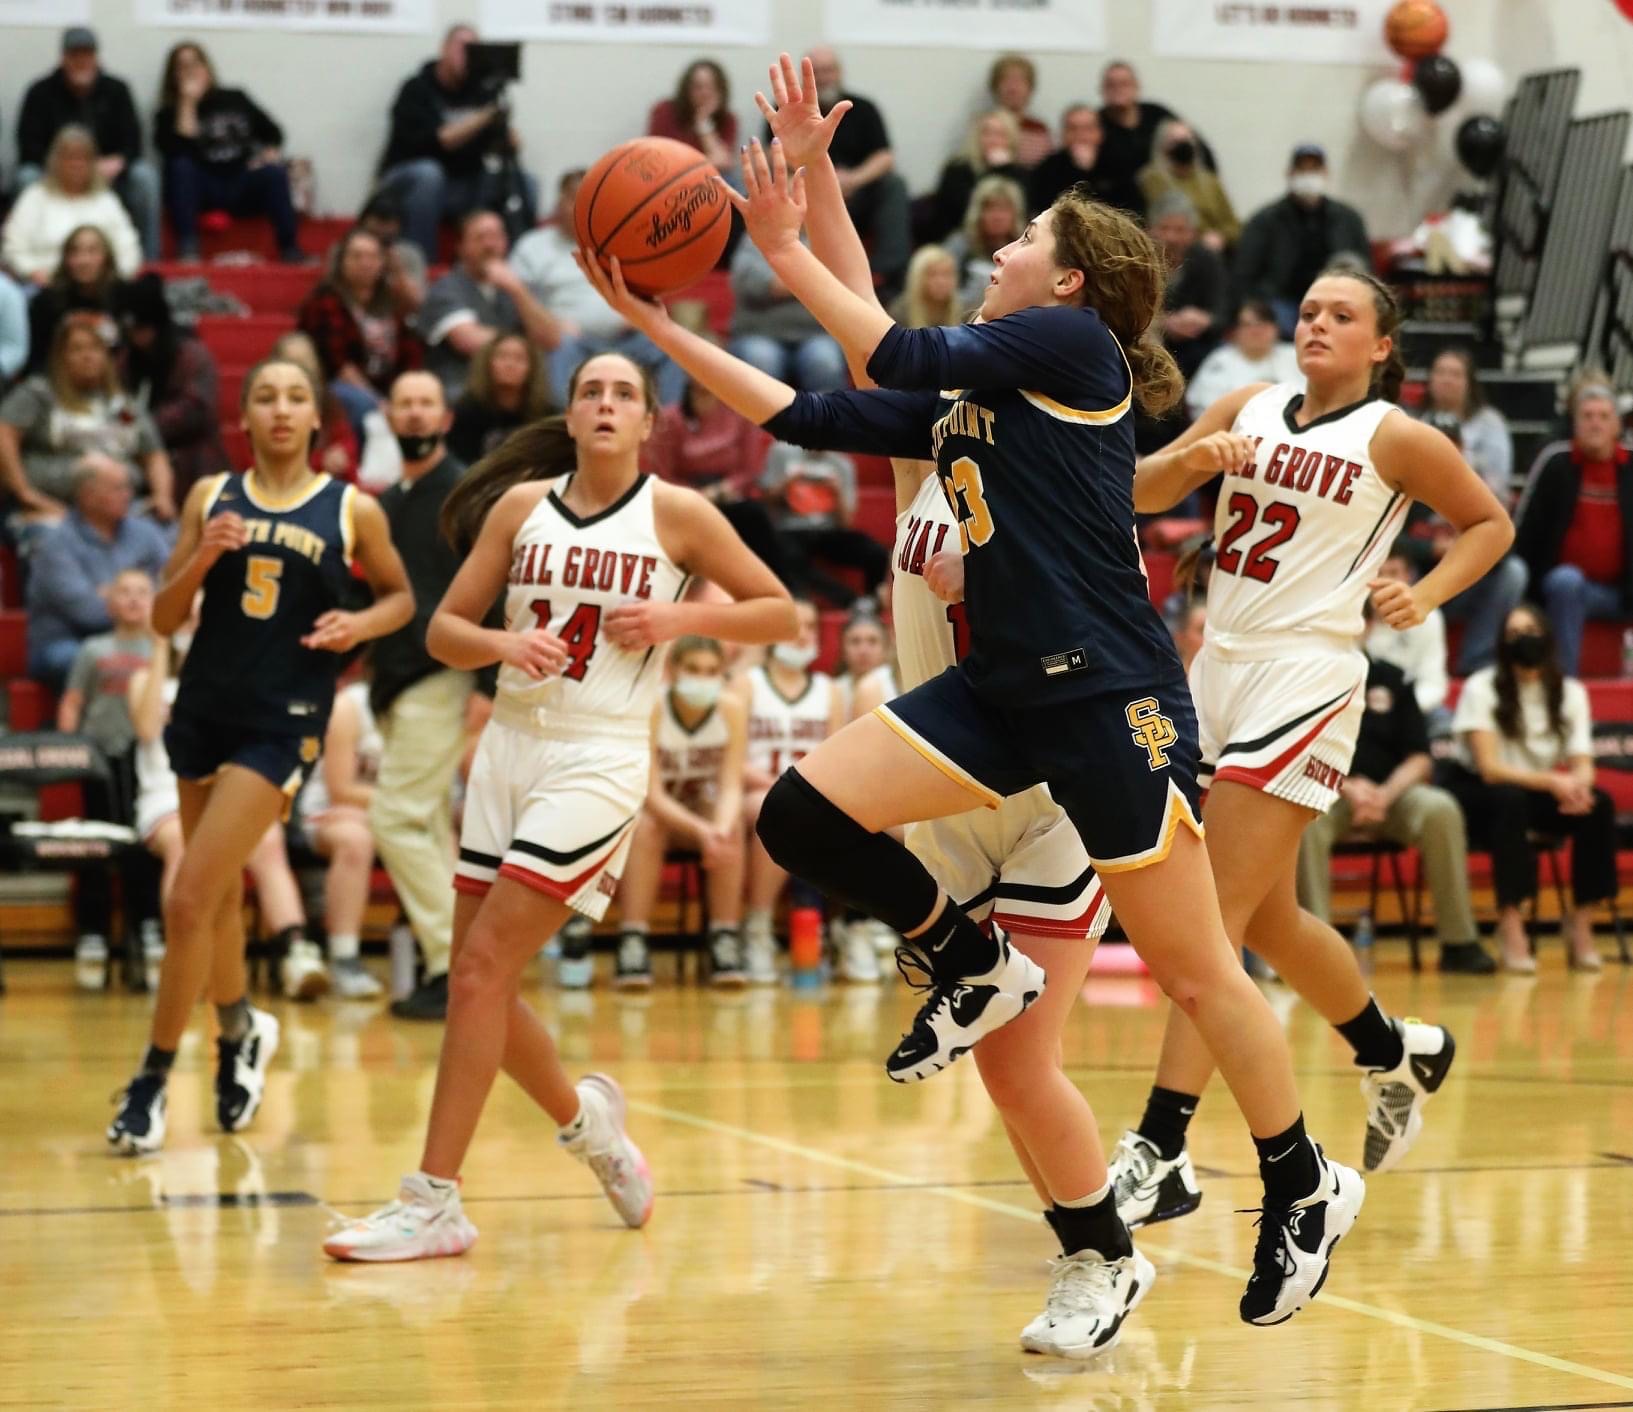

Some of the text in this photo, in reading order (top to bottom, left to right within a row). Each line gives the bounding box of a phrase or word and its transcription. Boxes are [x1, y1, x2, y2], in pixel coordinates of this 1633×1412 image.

[646, 174, 719, 248] Rawlings
[1264, 443, 1363, 506] GROVE
[272, 522, 326, 566] POINT
[1216, 491, 1301, 584] 22
[241, 554, 284, 620] 5
[562, 546, 657, 600] GROVE
[529, 598, 602, 683] 14
[1071, 655, 1082, 665] M
[1124, 696, 1179, 772] SP
